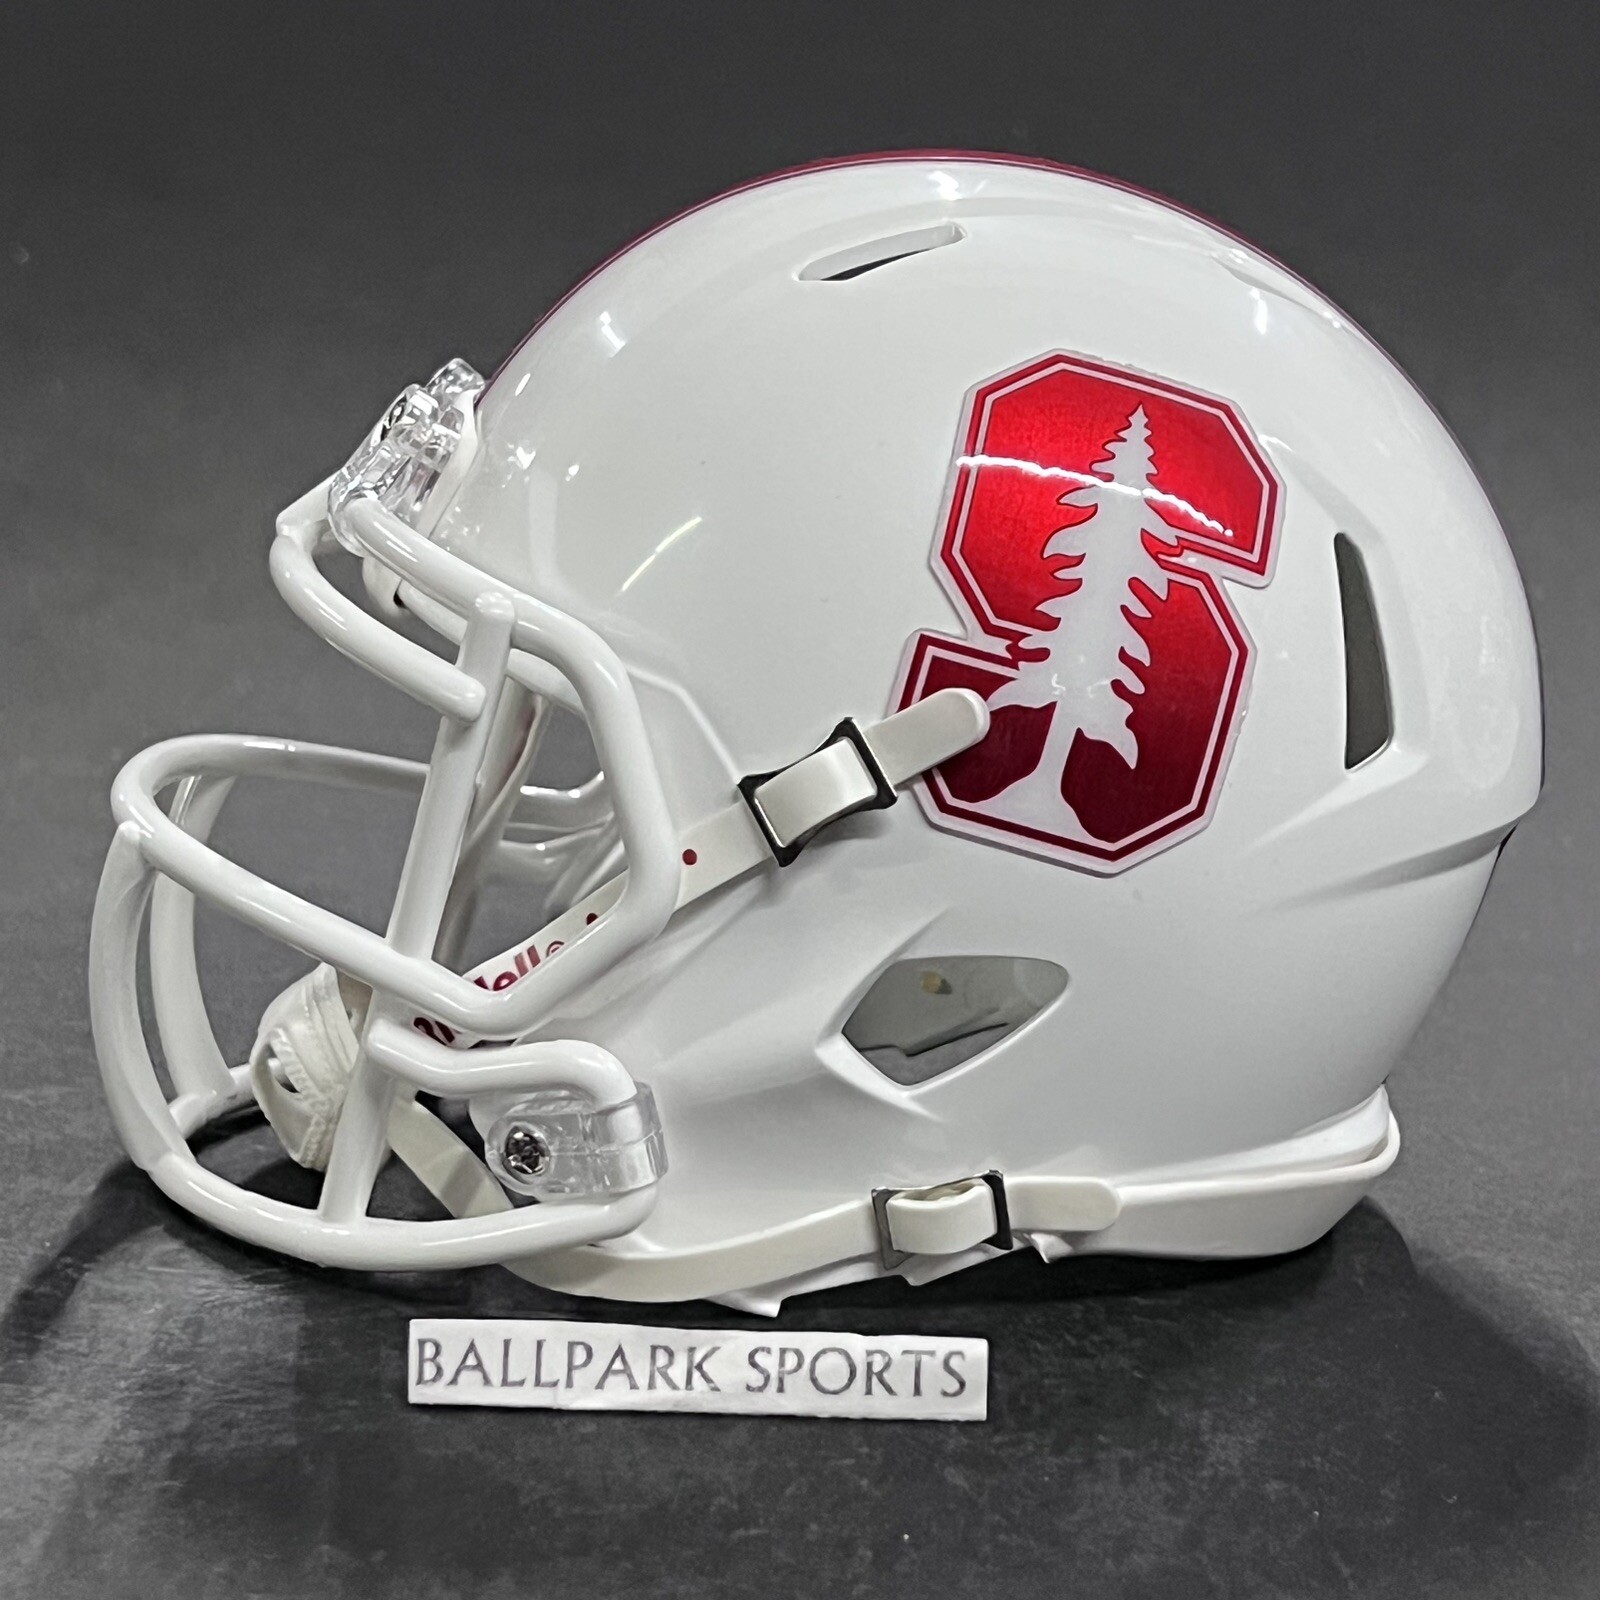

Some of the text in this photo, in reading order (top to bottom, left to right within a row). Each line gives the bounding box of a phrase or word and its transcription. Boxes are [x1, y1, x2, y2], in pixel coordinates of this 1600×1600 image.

[896, 352, 1279, 864] S
[415, 1337, 967, 1398] BALLPARK SPORTS
